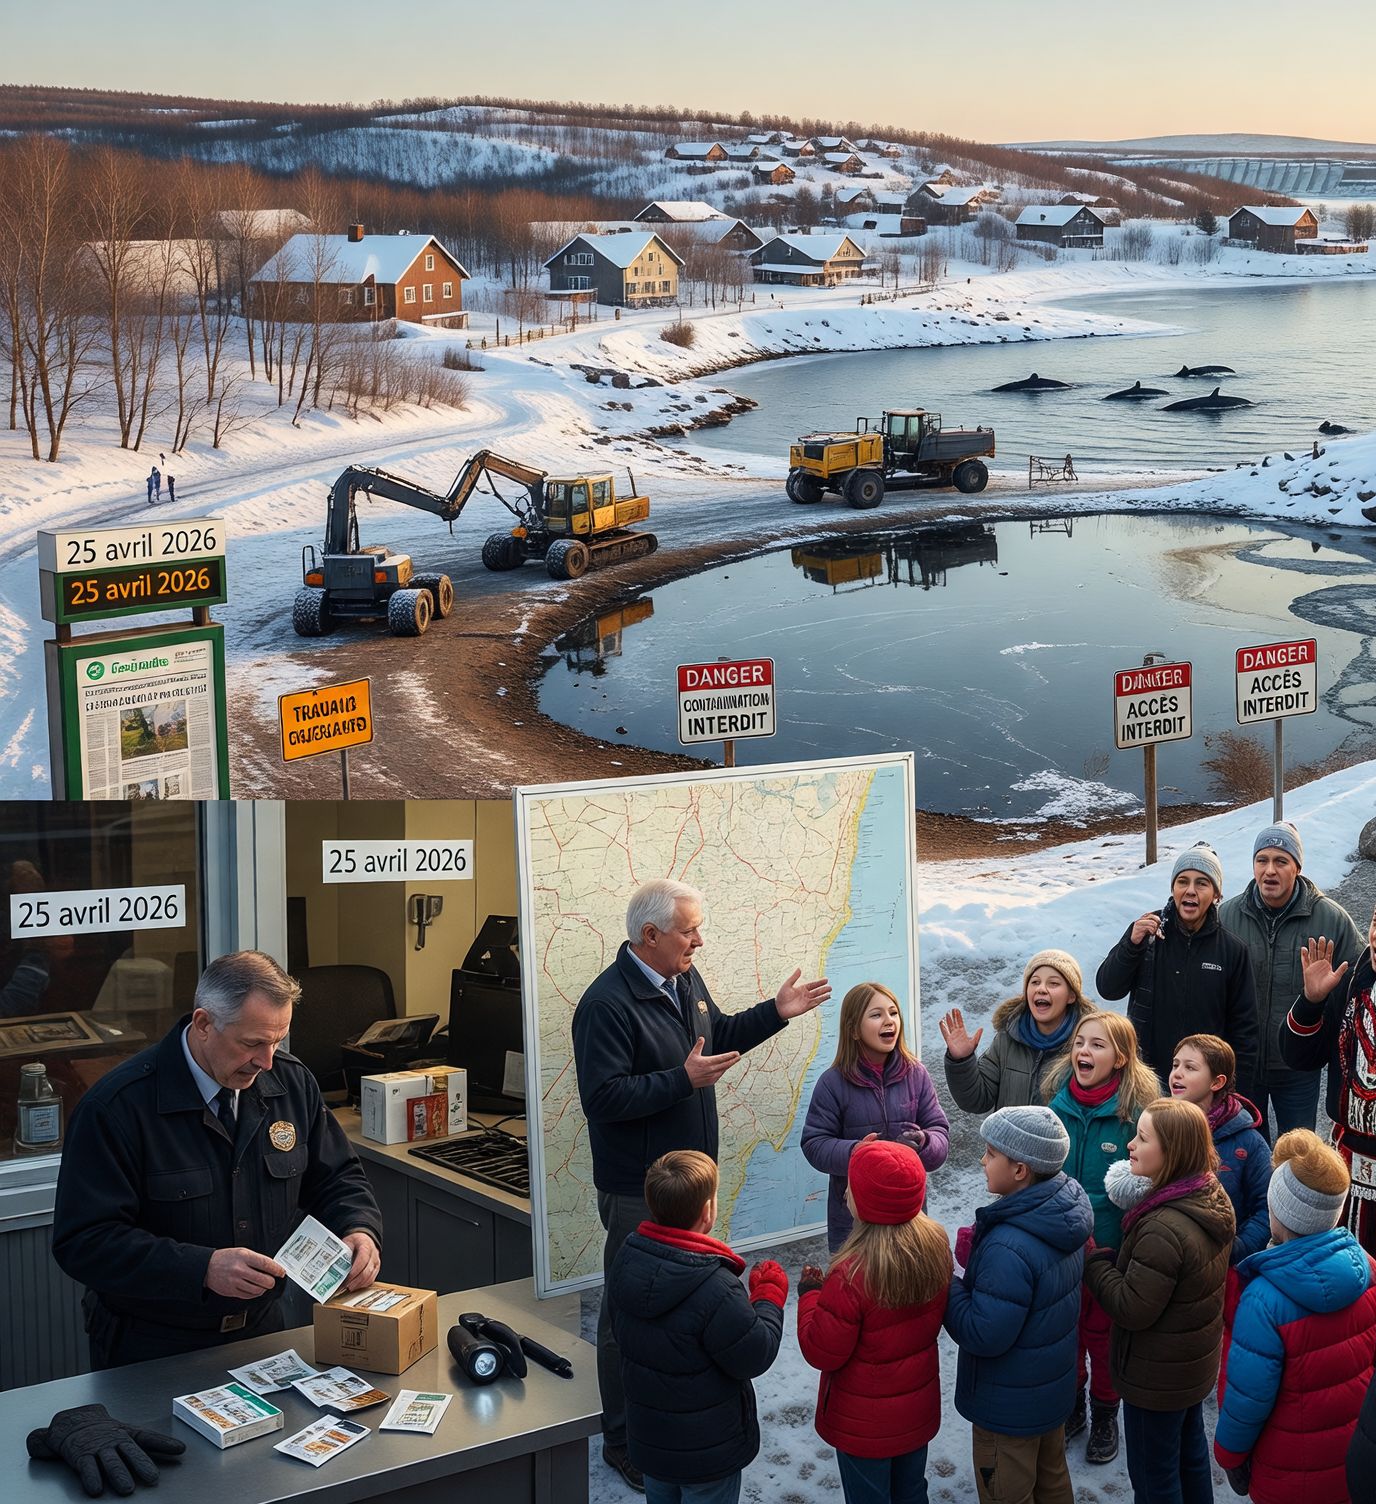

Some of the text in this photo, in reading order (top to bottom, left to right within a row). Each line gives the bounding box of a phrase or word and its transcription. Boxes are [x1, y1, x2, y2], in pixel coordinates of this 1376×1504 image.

[67, 528, 216, 565] 25 avril 2026
[71, 568, 210, 605] 25 avril 2026
[1243, 645, 1308, 669] DANGER
[686, 665, 764, 687] DANGER
[1243, 691, 1309, 716] INTERDIT
[688, 712, 767, 735] INTERDIT
[1122, 716, 1186, 741] INTERDIT
[329, 848, 466, 873] 25 avril 2026
[18, 894, 178, 928] 25 avril 2026
